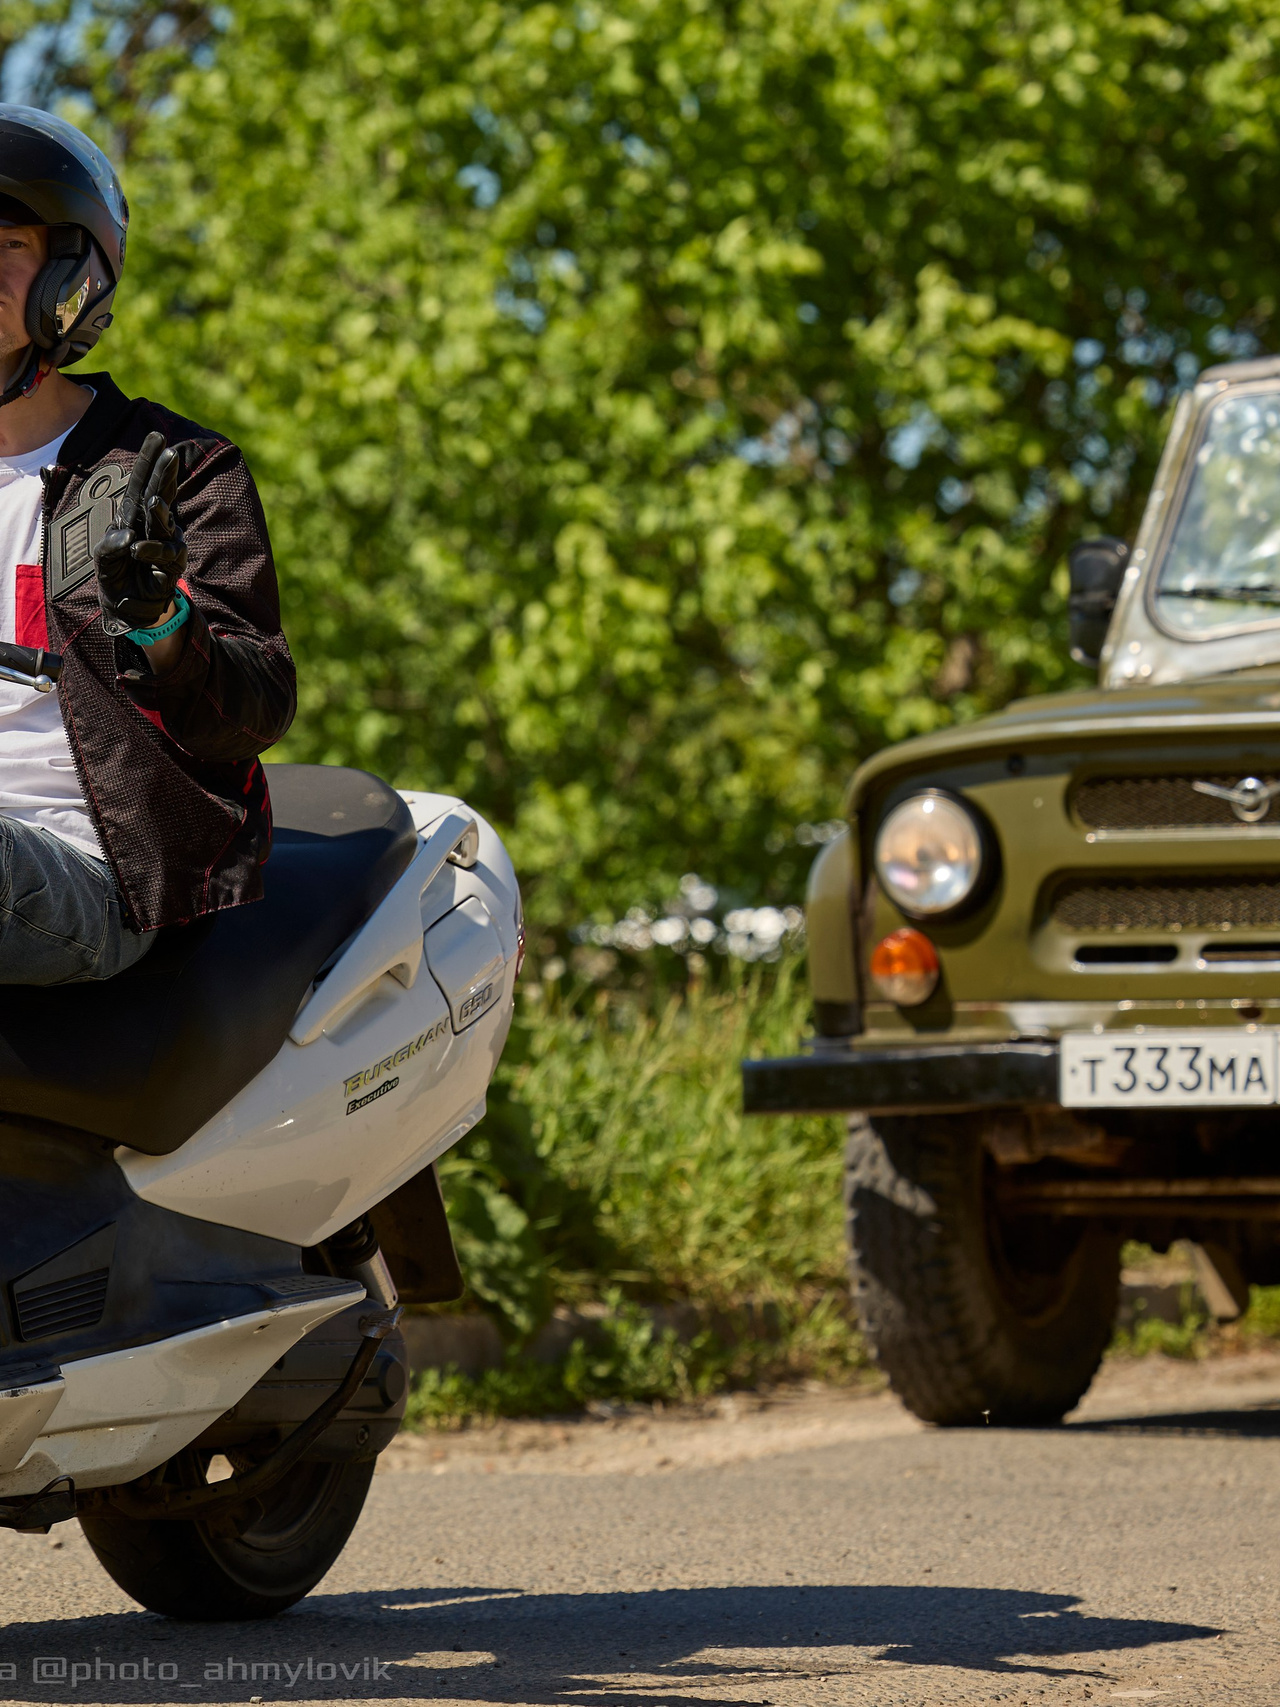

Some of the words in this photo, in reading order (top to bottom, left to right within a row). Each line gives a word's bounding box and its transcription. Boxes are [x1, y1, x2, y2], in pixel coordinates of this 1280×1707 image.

[344, 1018, 449, 1097] BURGMAN
[459, 983, 493, 1021] 650
[347, 1078, 399, 1114] Executive
